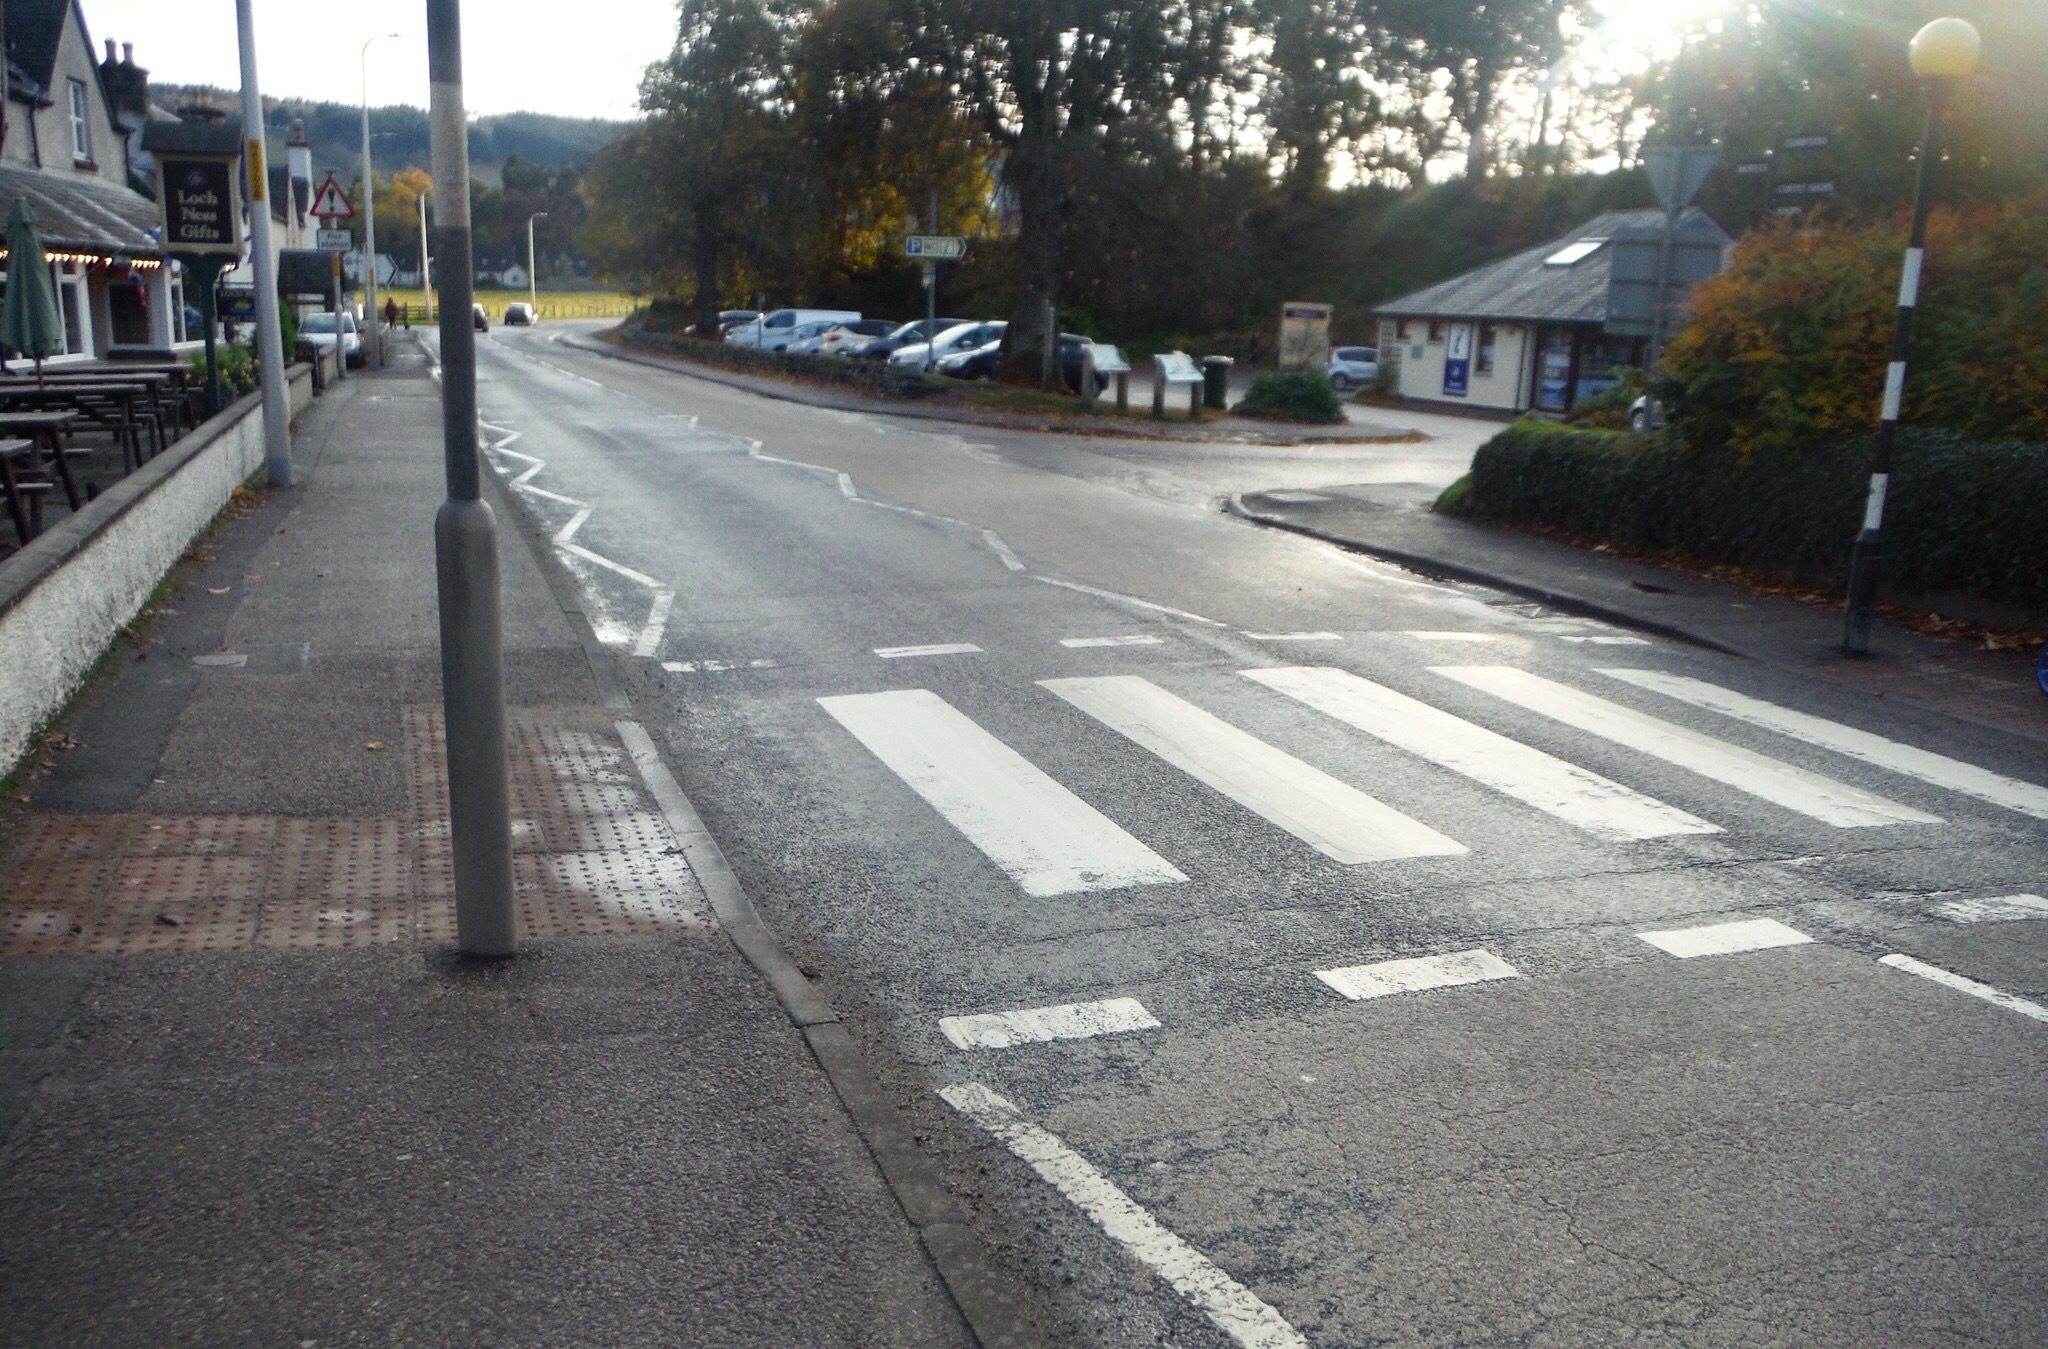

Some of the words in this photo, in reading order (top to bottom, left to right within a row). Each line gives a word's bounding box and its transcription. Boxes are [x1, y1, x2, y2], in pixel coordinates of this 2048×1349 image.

[177, 189, 218, 204] Loch
[181, 206, 218, 221] Ness
[180, 224, 220, 238] Gifts
[911, 238, 921, 252] P
